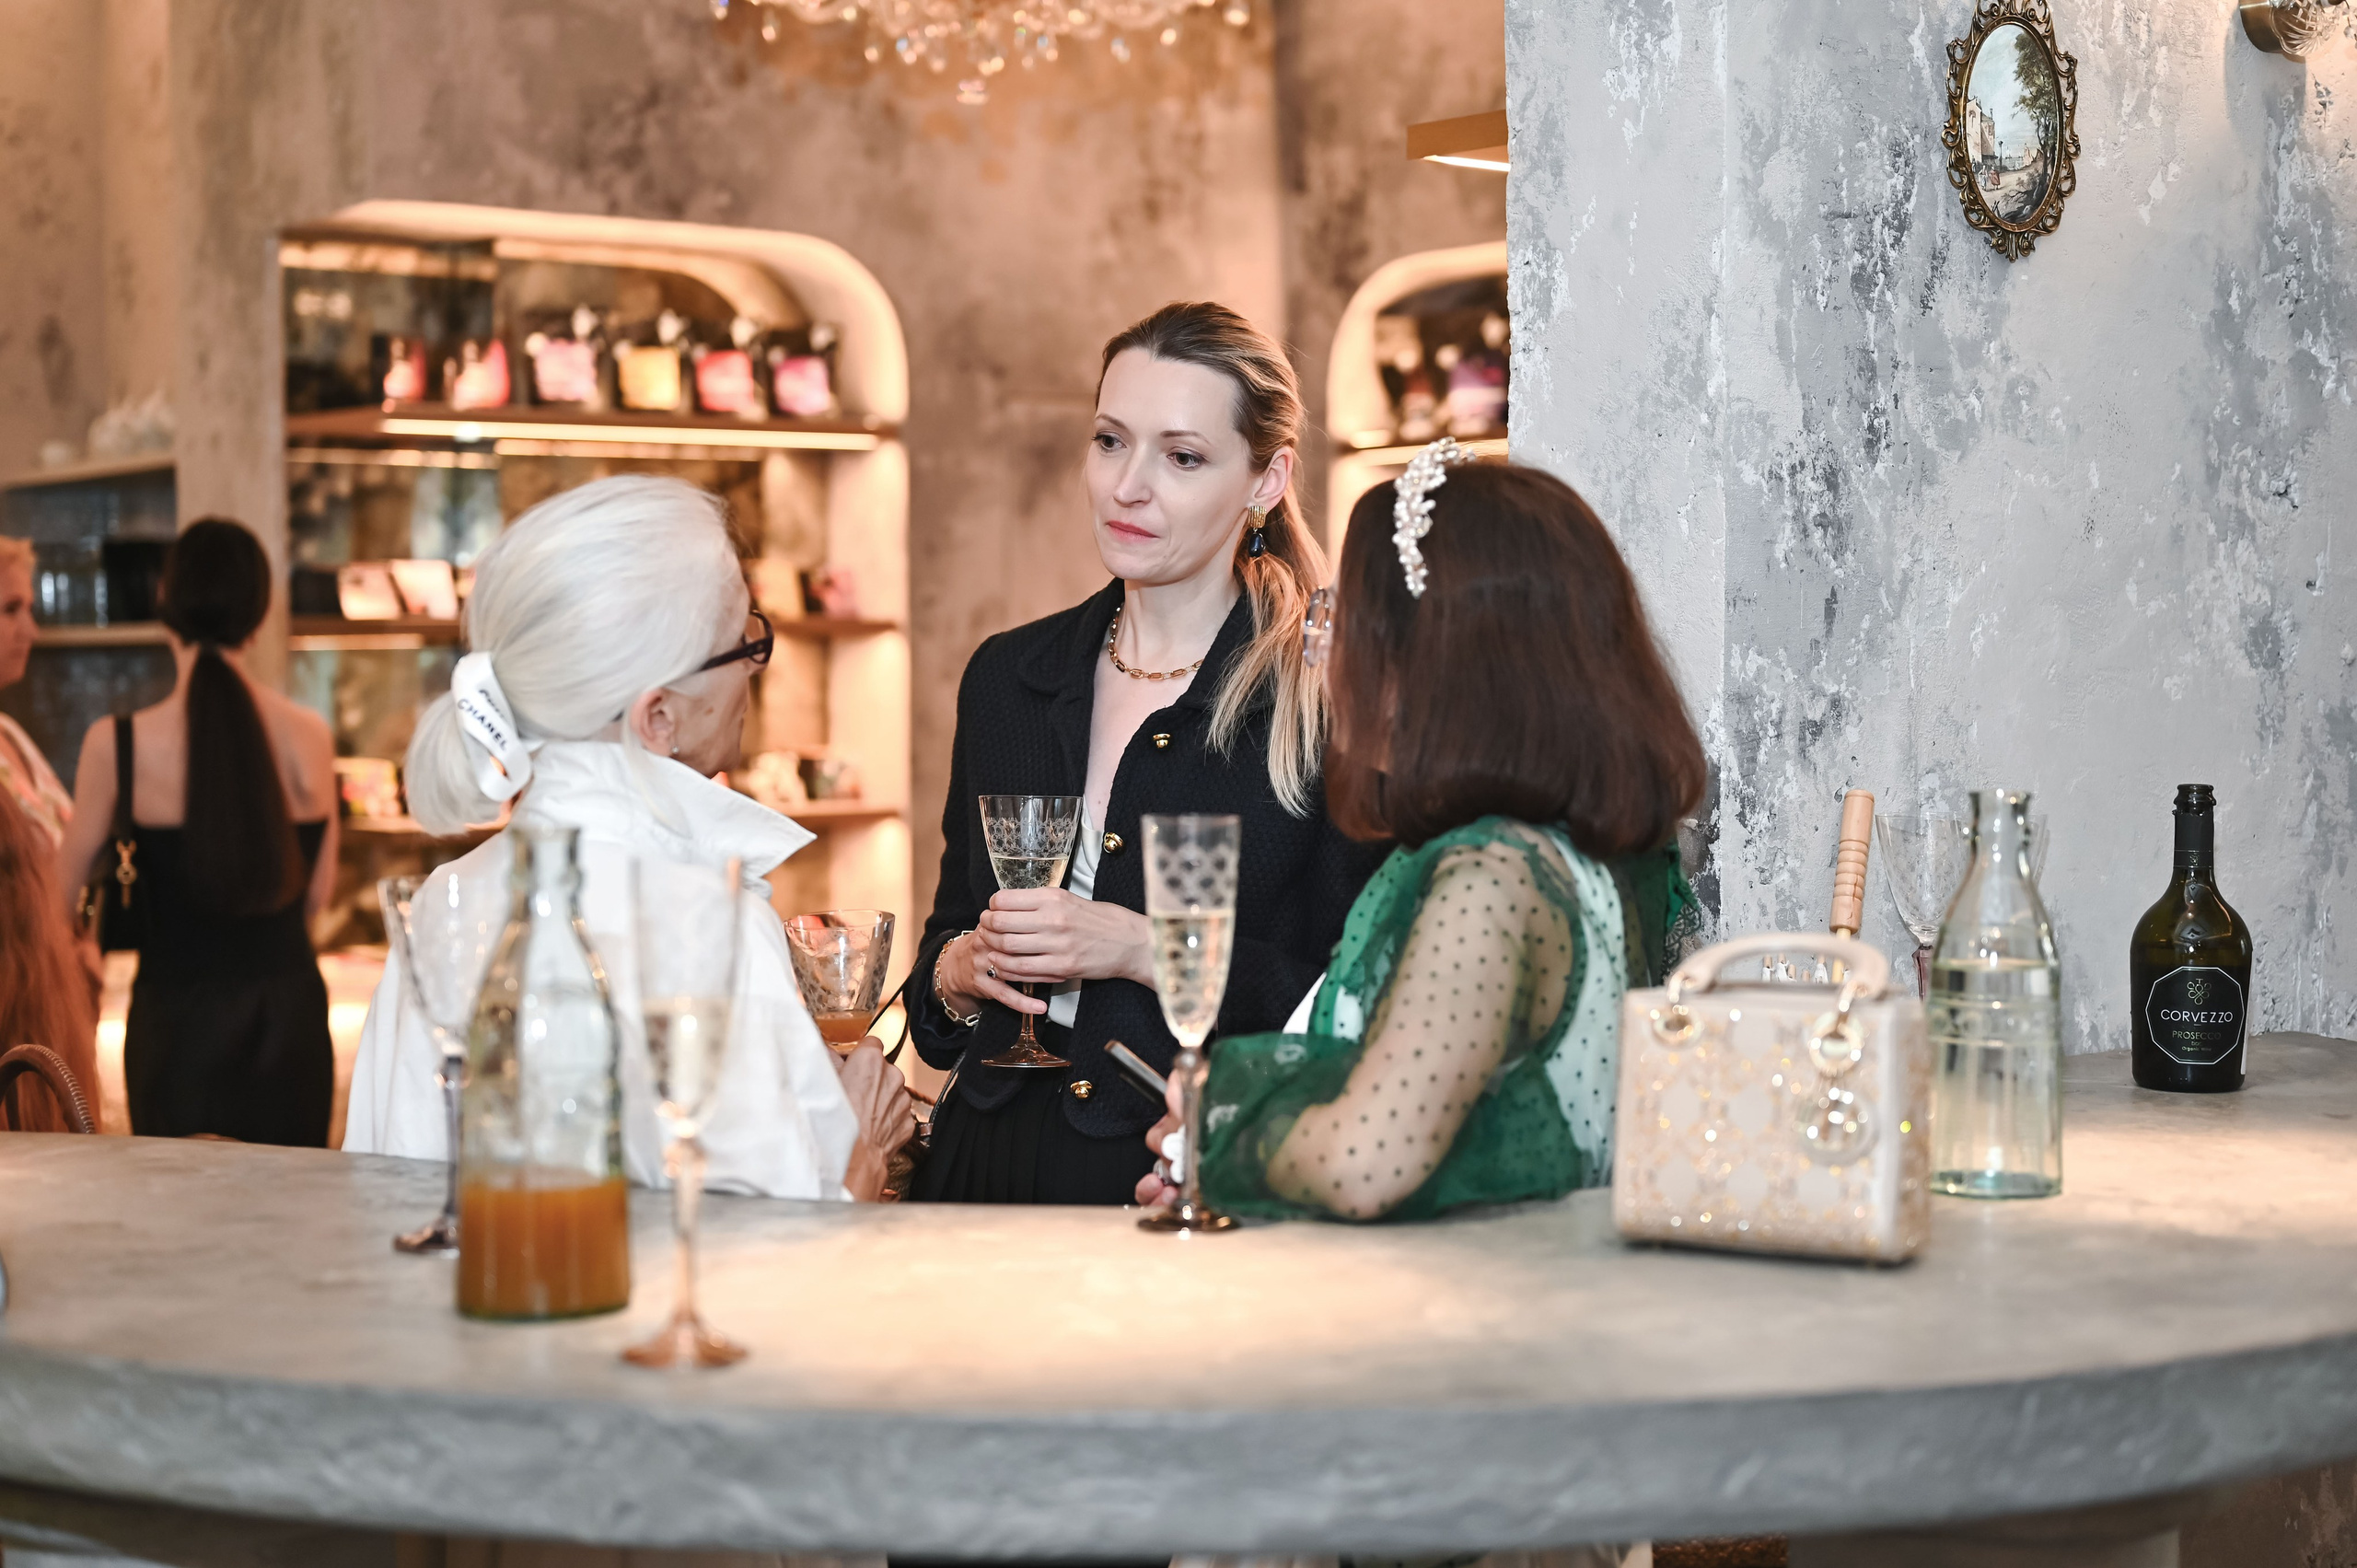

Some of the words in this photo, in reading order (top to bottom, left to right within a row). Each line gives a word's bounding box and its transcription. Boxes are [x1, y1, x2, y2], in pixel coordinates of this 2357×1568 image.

[458, 698, 505, 749] CHANEL
[2160, 1009, 2234, 1023] CORVEZZO
[2172, 1030, 2221, 1040] PROSECCO
